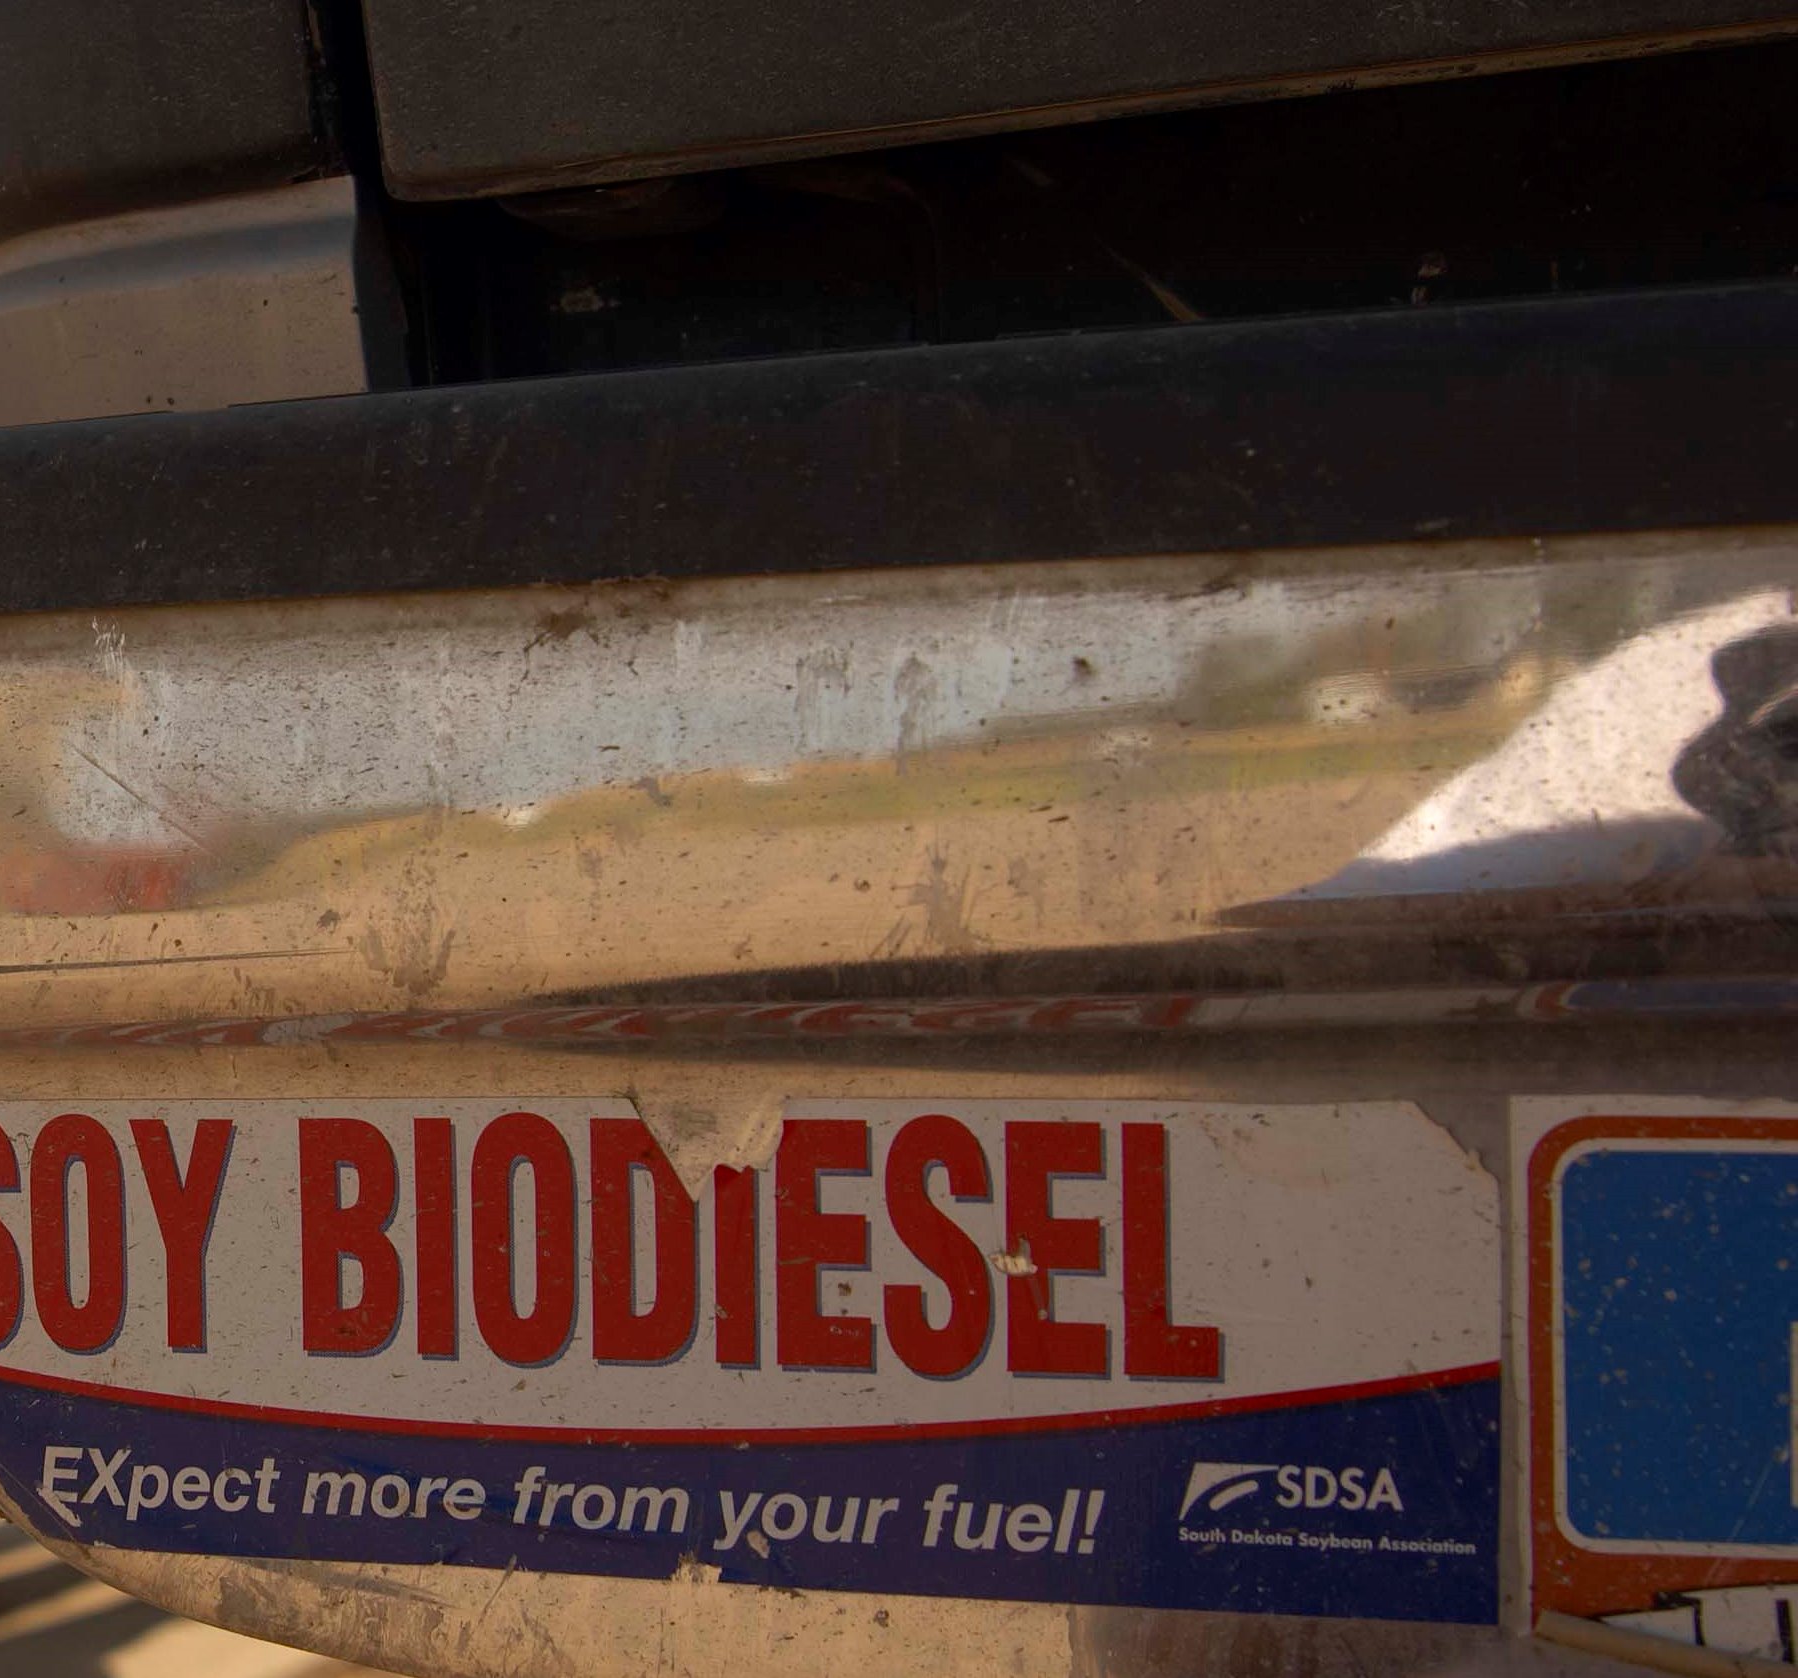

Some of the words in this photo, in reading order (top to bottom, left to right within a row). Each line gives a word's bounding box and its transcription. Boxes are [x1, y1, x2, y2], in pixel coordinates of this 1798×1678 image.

[298, 1112, 1224, 1384] BIODIESEL
[40, 1446, 280, 1522] EXpect
[302, 1466, 486, 1520] more
[512, 1466, 690, 1534] from
[713, 1489, 899, 1550] your
[923, 1483, 1104, 1554] fuel!
[1275, 1464, 1404, 1512] SDSA
[1178, 1527, 1226, 1544] South
[1232, 1530, 1293, 1547] Dakota
[1298, 1533, 1373, 1551] Soybean
[1379, 1536, 1476, 1555] Association
